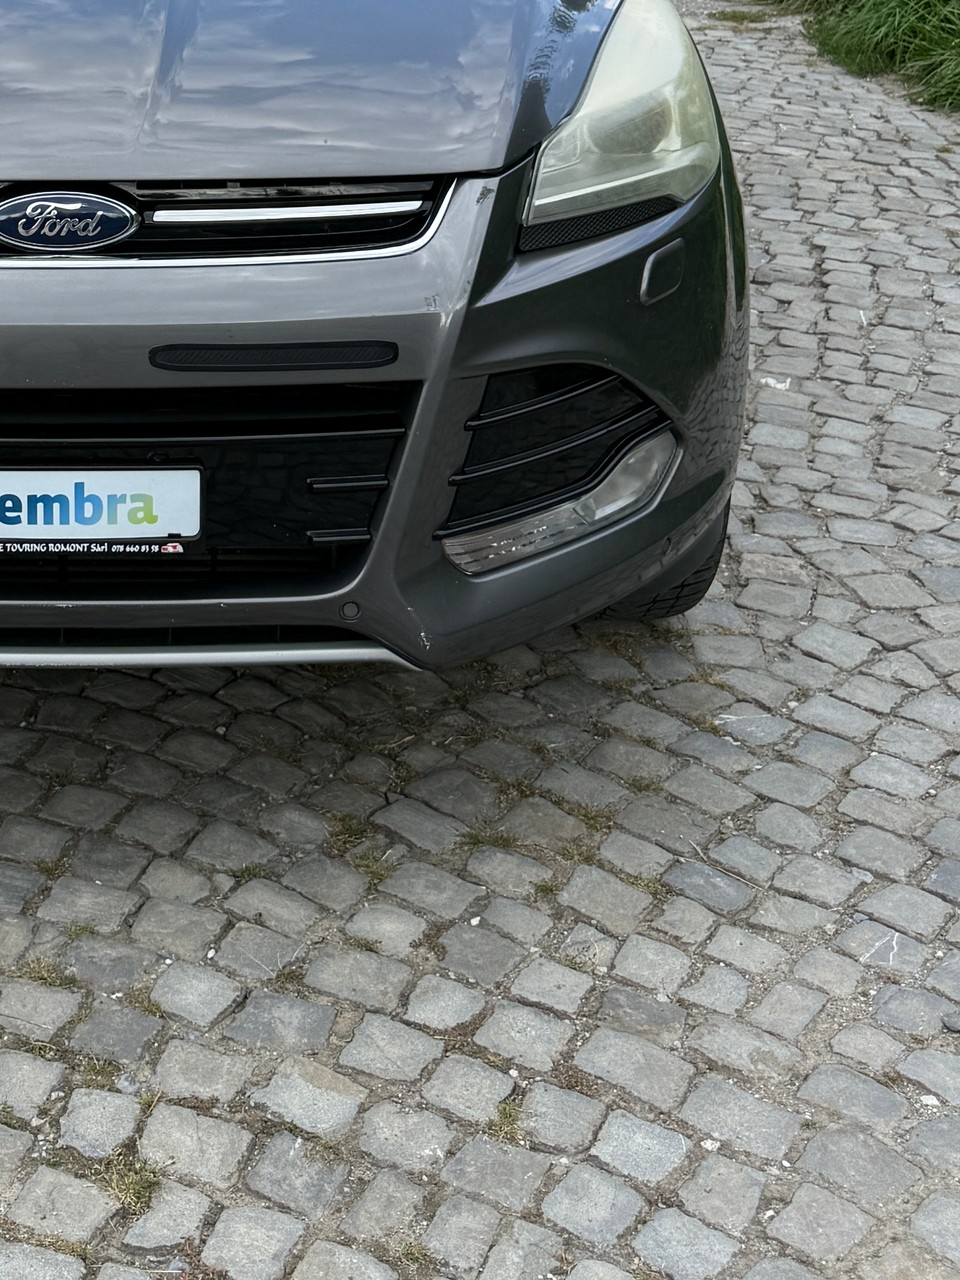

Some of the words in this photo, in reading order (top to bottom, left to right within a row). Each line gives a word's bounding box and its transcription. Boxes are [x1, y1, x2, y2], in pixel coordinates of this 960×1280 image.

[17, 201, 104, 237] Ford
[6, 543, 47, 552] TOURING
[48, 543, 90, 552] ROMONT
